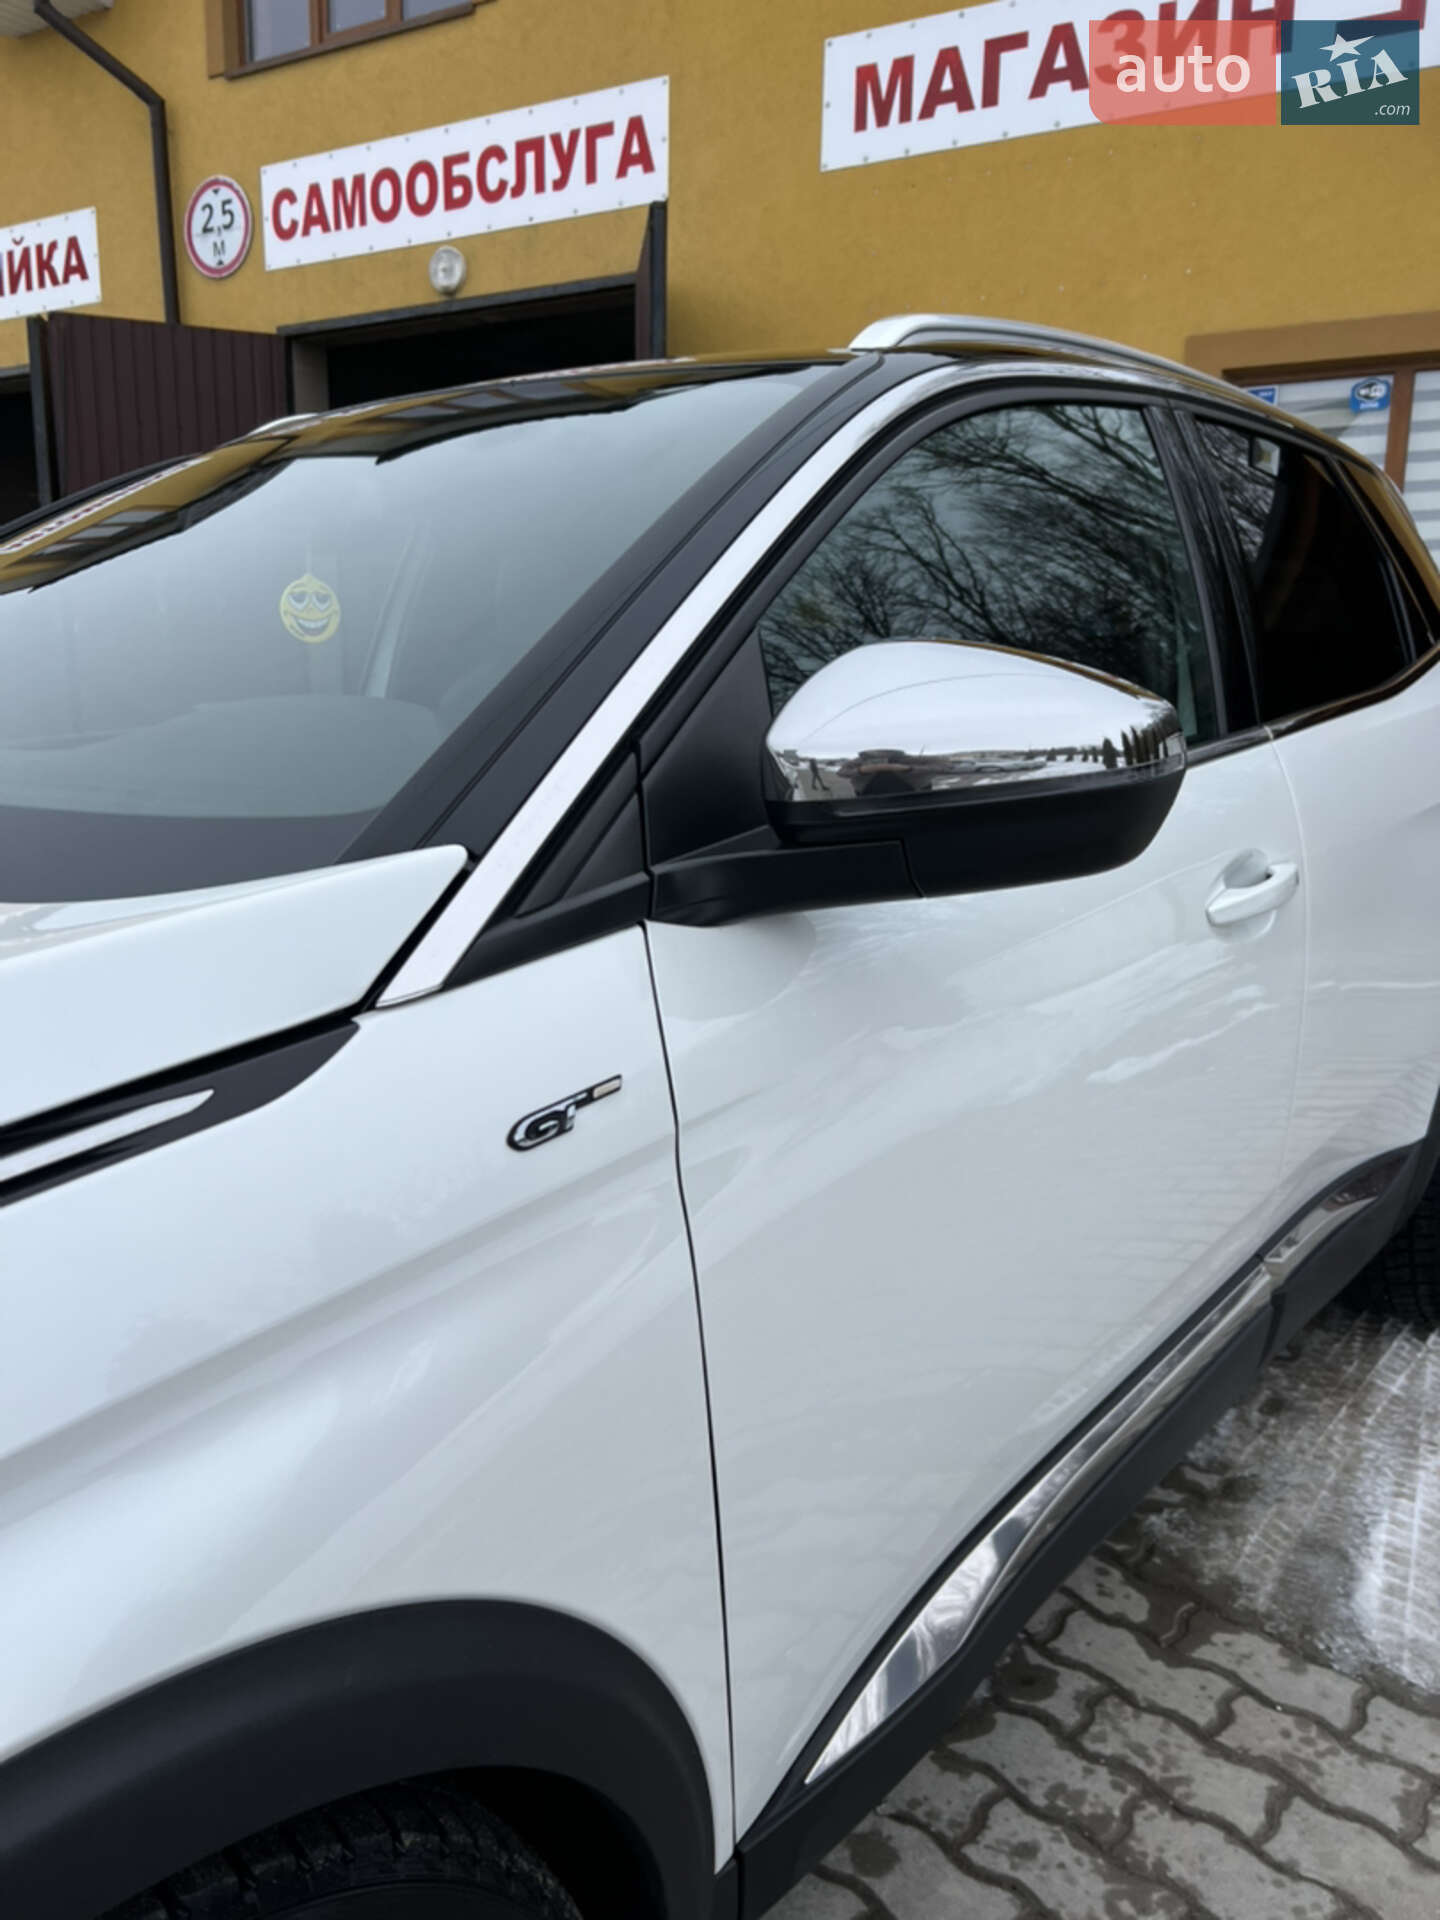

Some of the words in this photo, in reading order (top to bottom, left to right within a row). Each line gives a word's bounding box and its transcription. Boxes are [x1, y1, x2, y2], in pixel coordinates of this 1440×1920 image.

[854, 0, 1294, 133] МАГАЗИН
[201, 198, 235, 236] 2,5
[271, 114, 656, 241] САМООБСЛУГА
[508, 1086, 592, 1151] GT
